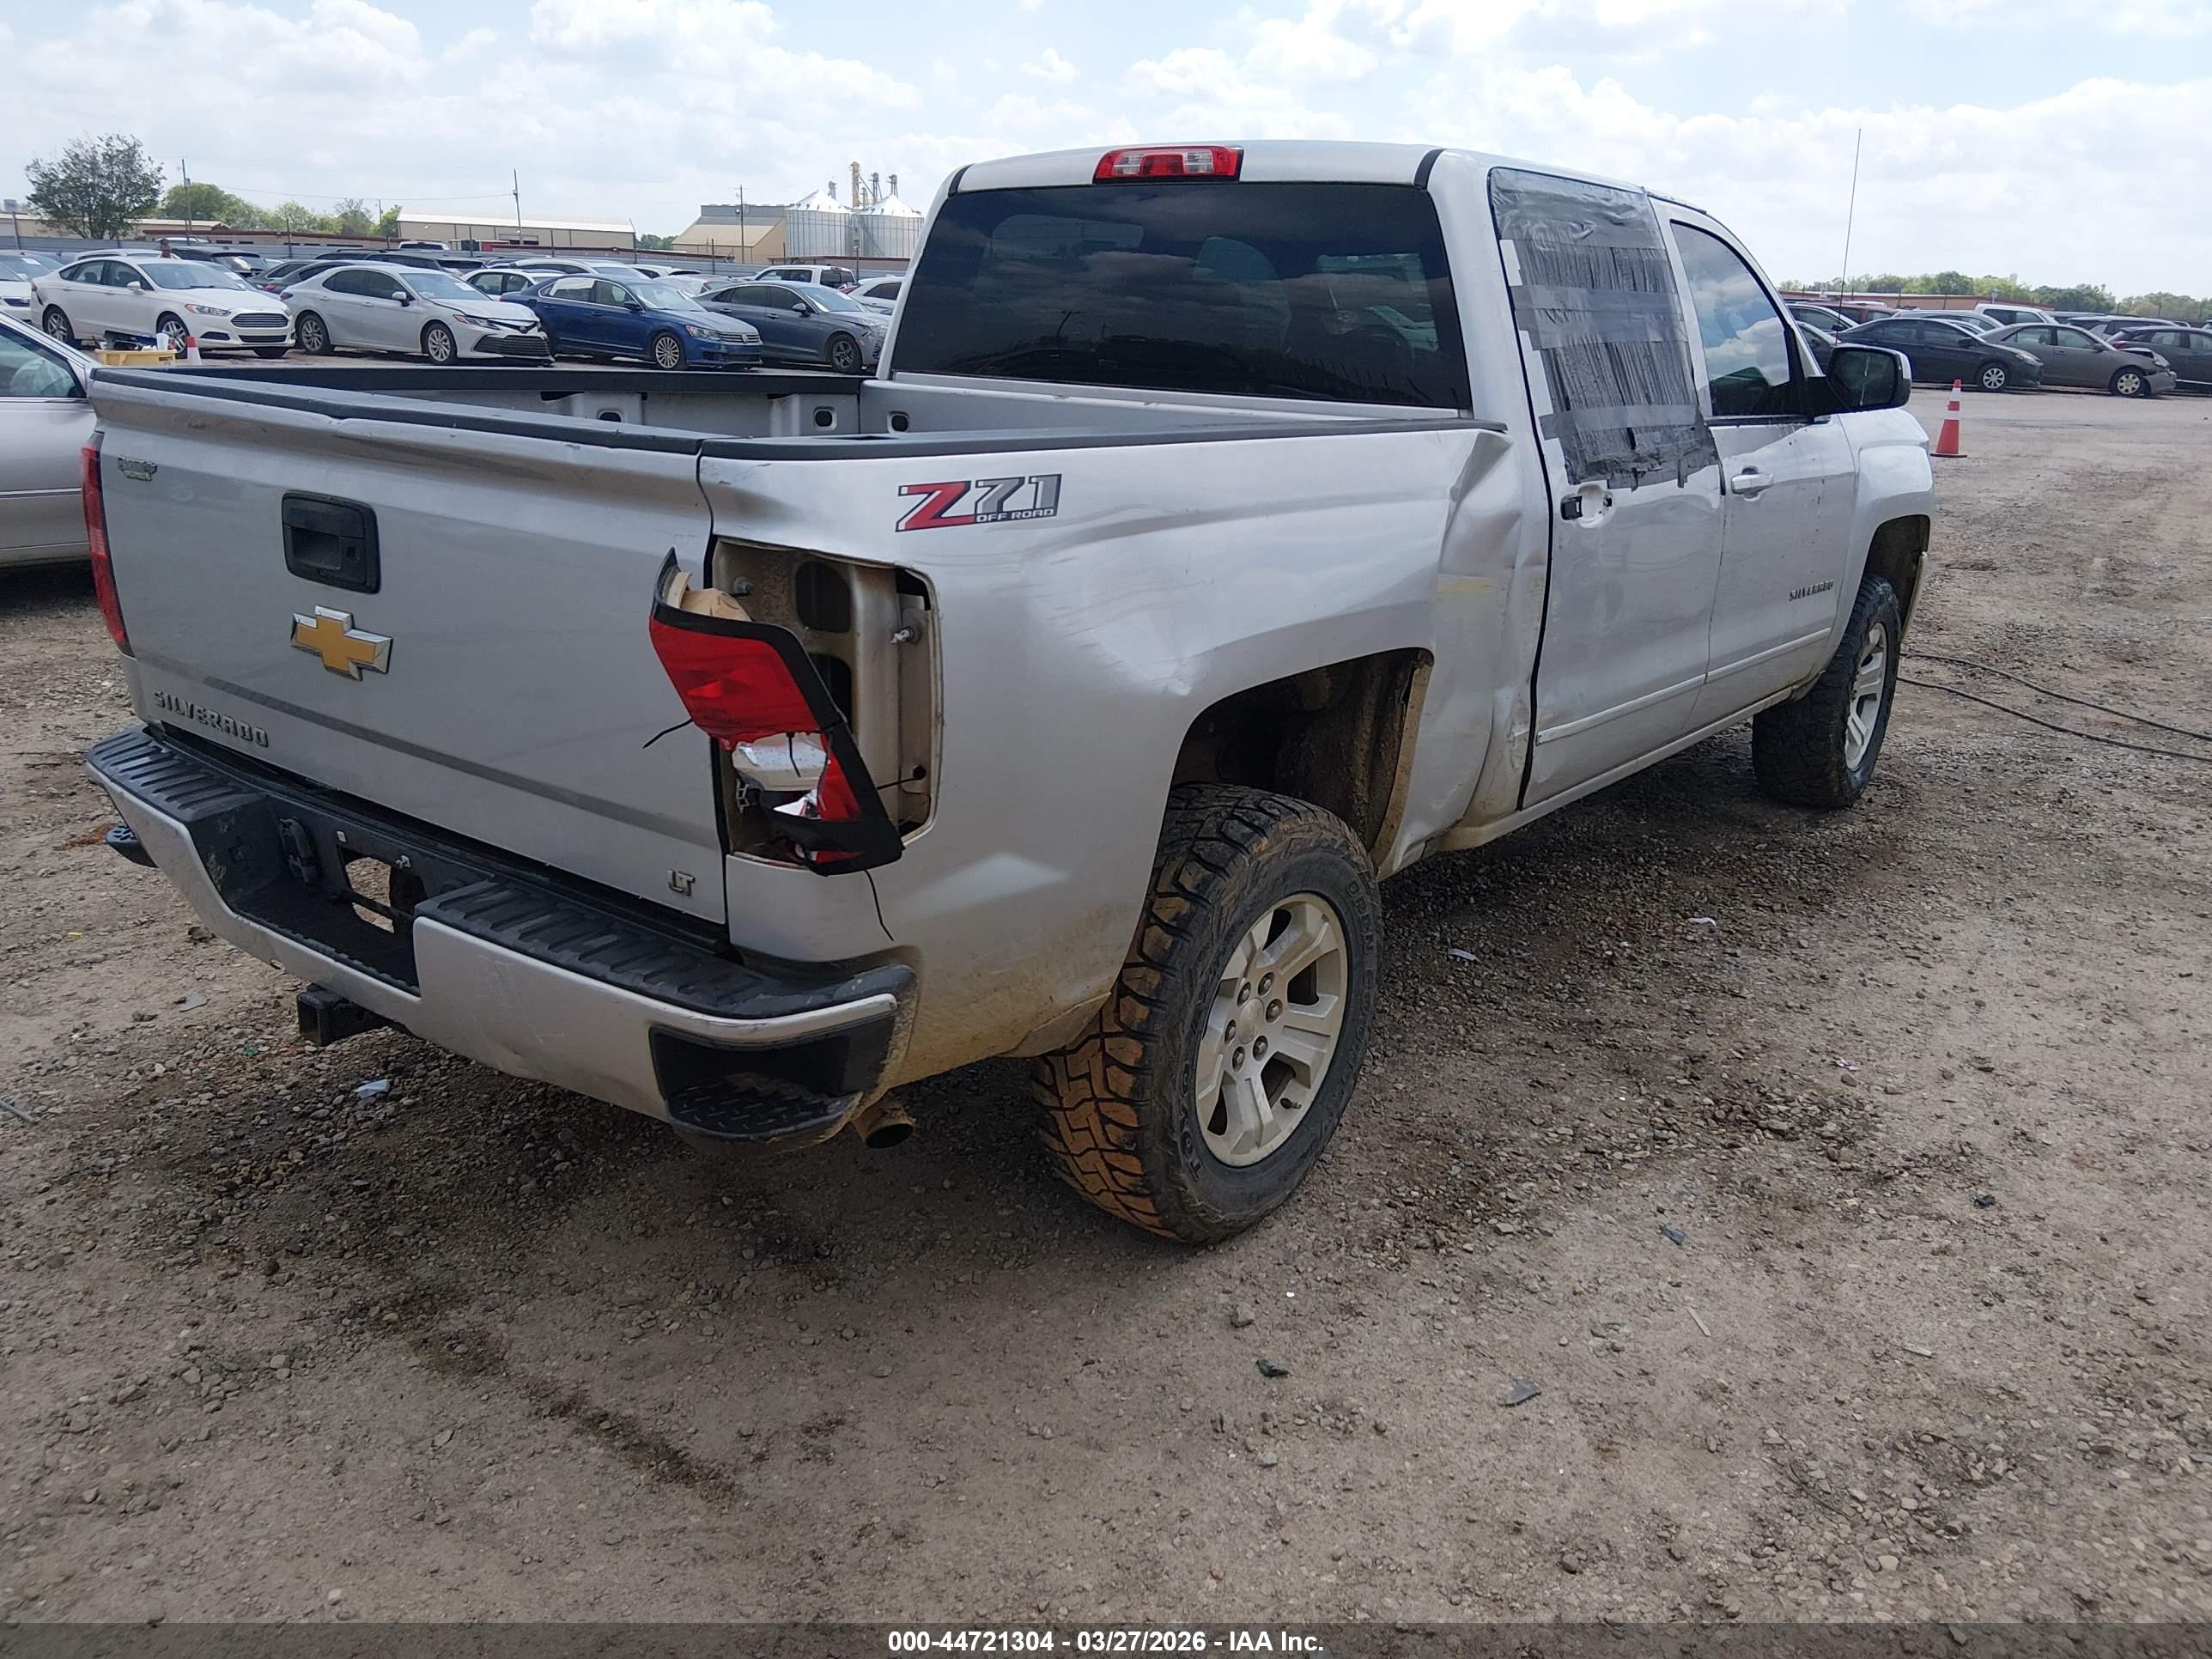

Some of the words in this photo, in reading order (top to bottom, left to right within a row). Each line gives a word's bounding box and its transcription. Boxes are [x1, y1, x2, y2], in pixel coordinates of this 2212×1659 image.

[895, 473, 1062, 532] Z71
[975, 513, 1009, 524] OFF
[1011, 507, 1054, 520] ROAD
[152, 689, 270, 748] SILVERADO
[666, 870, 696, 896] LT
[1180, 1062, 1204, 1182] TOYO
